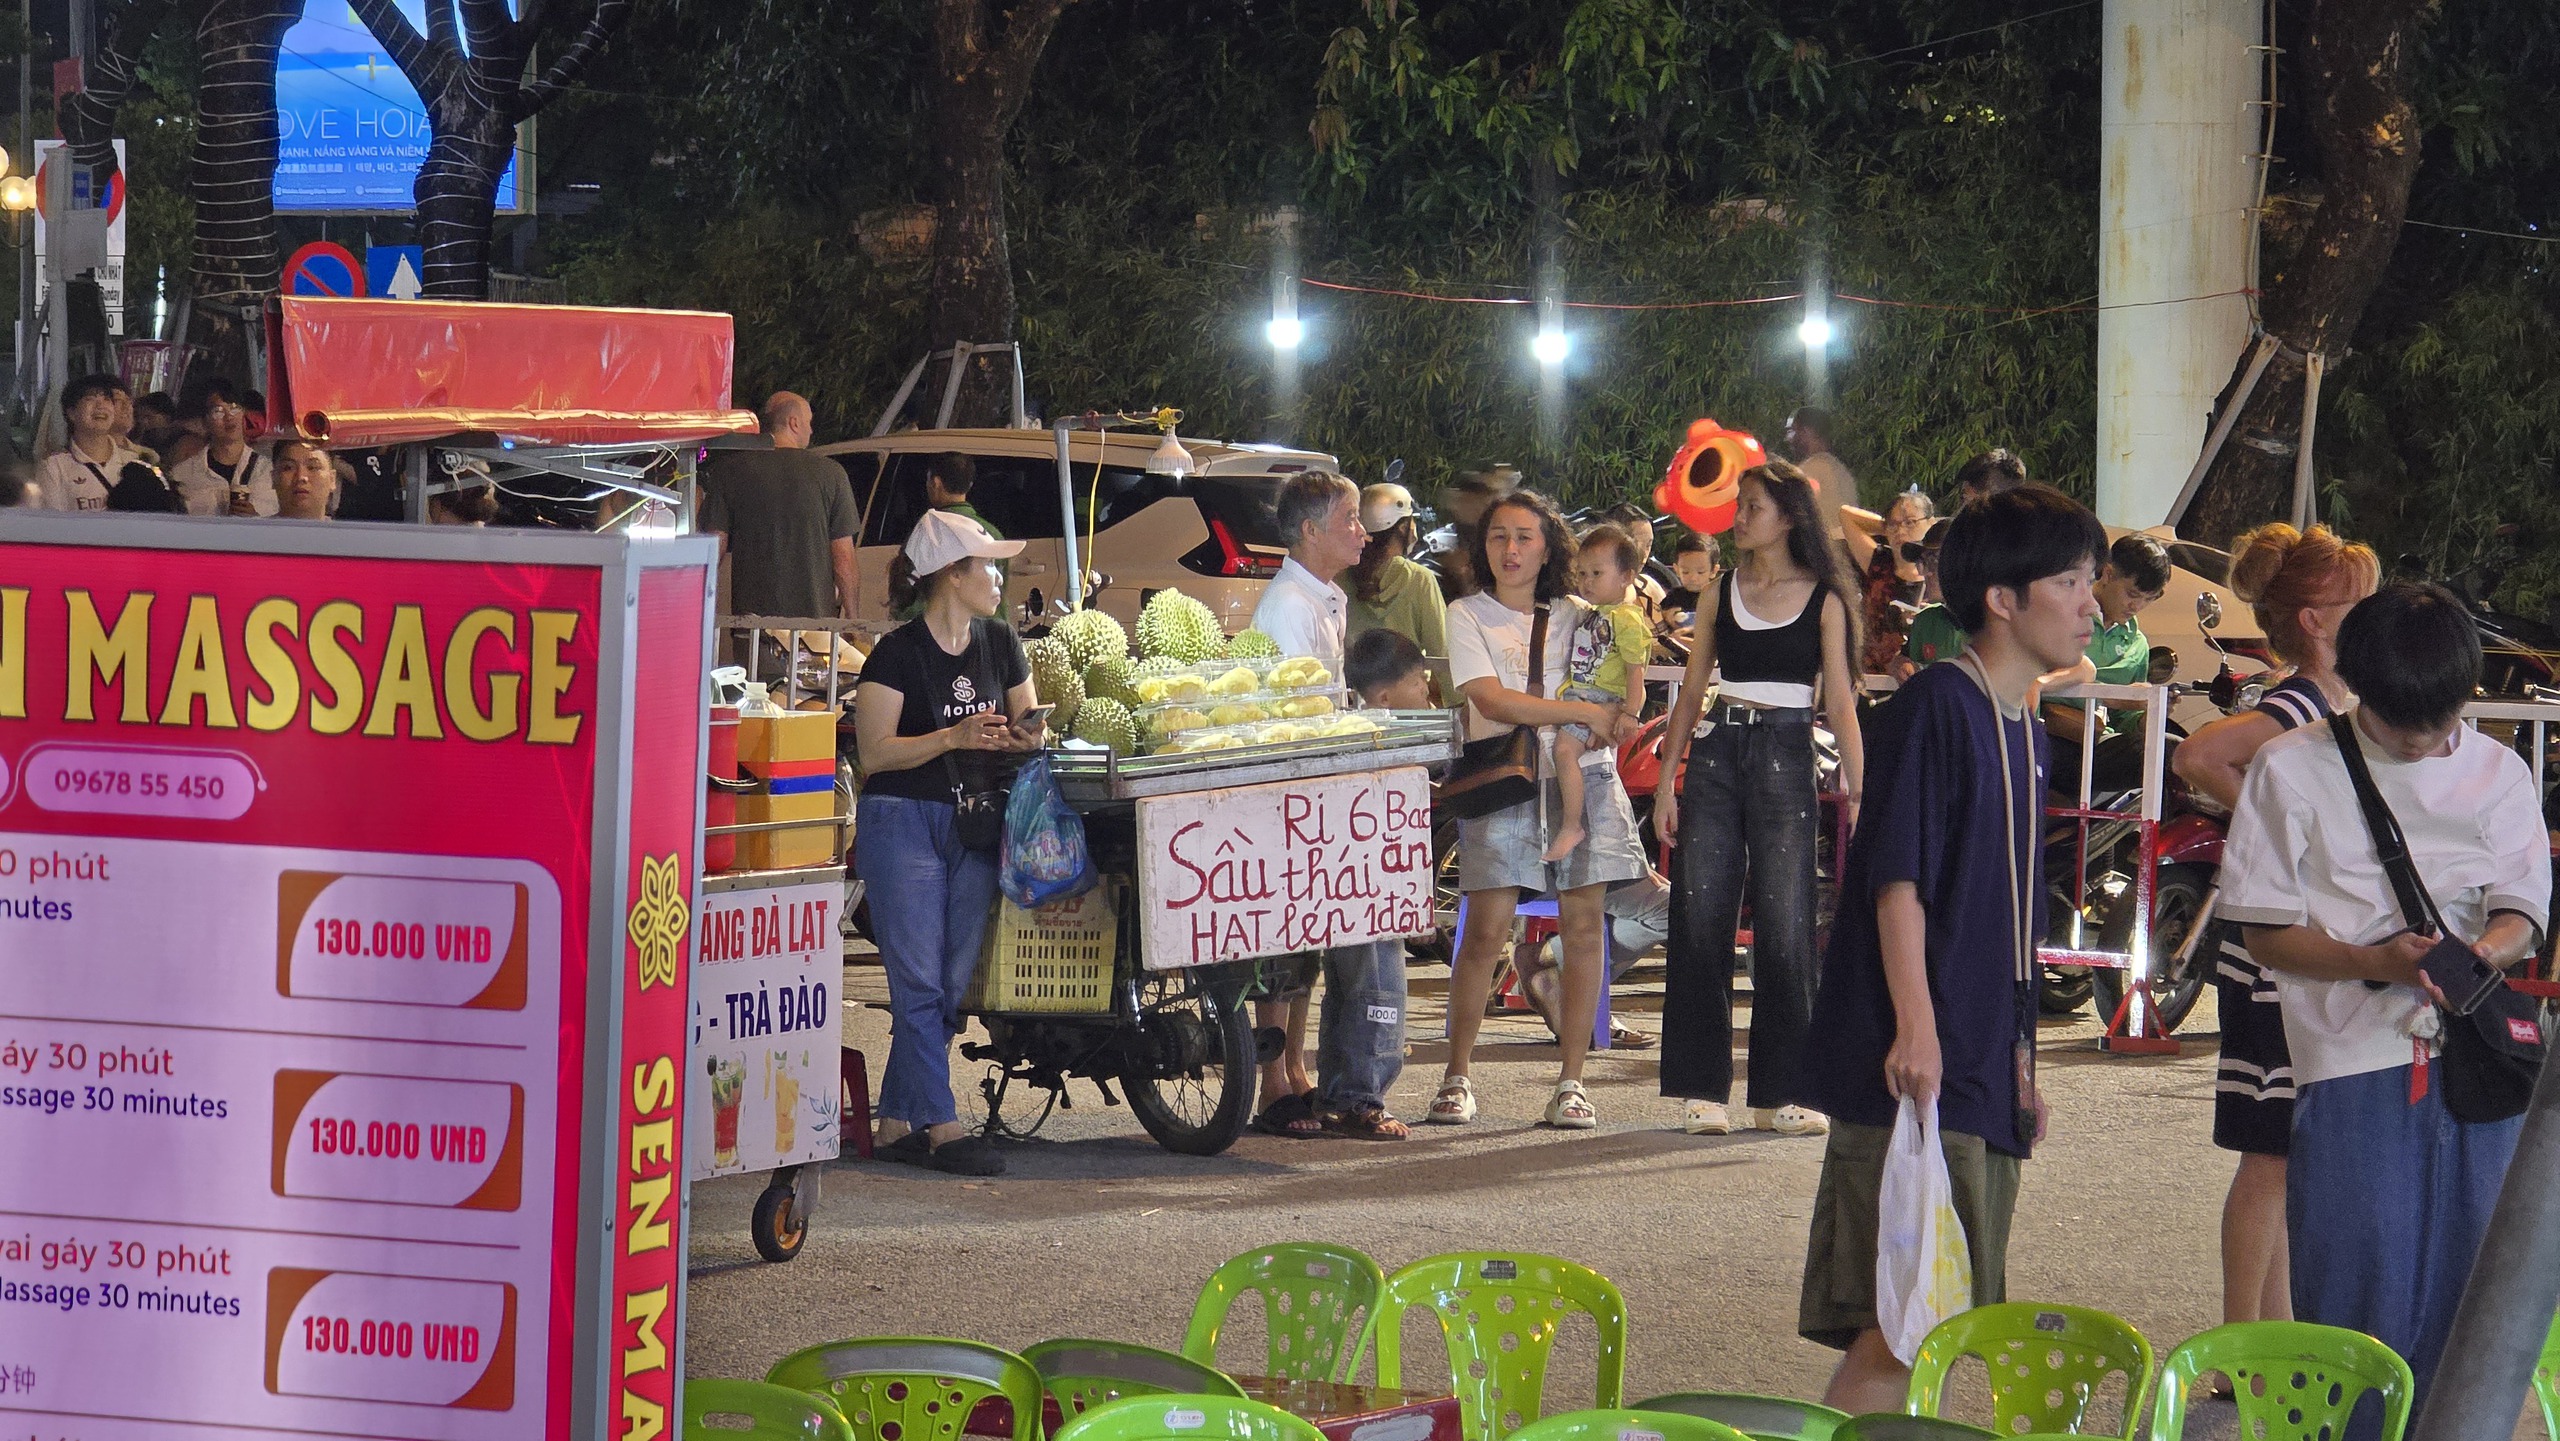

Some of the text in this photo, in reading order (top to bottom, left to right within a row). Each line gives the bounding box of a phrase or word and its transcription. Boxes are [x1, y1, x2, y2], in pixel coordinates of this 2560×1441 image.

[63, 588, 584, 745] MASSAGE
[54, 768, 225, 800] 09678 55 450
[1350, 787, 1378, 842] 6
[29, 850, 110, 884] phút
[1166, 820, 1277, 909] Sầu
[1279, 844, 1381, 901] thái
[314, 917, 492, 964] 130.000 VNĐ
[751, 894, 782, 957] ĐÀ
[788, 900, 828, 963] LẠT
[1191, 909, 1272, 965] HẠT
[725, 980, 772, 1041] TRÀ
[778, 974, 827, 1034] ĐÀO
[48, 1042, 88, 1071] 30
[98, 1044, 174, 1078] phút
[83, 1086, 114, 1112] 30
[122, 1088, 229, 1118] minutes
[309, 1117, 487, 1164] 130.000 VNĐ
[41, 1236, 98, 1273] gáy
[107, 1240, 146, 1270] 30
[156, 1244, 232, 1278] phút
[621, 1055, 676, 1441] SEN MA
[0, 1276, 241, 1317] assage 30 minutes
[302, 1315, 480, 1364] 130.000 VNĐ
